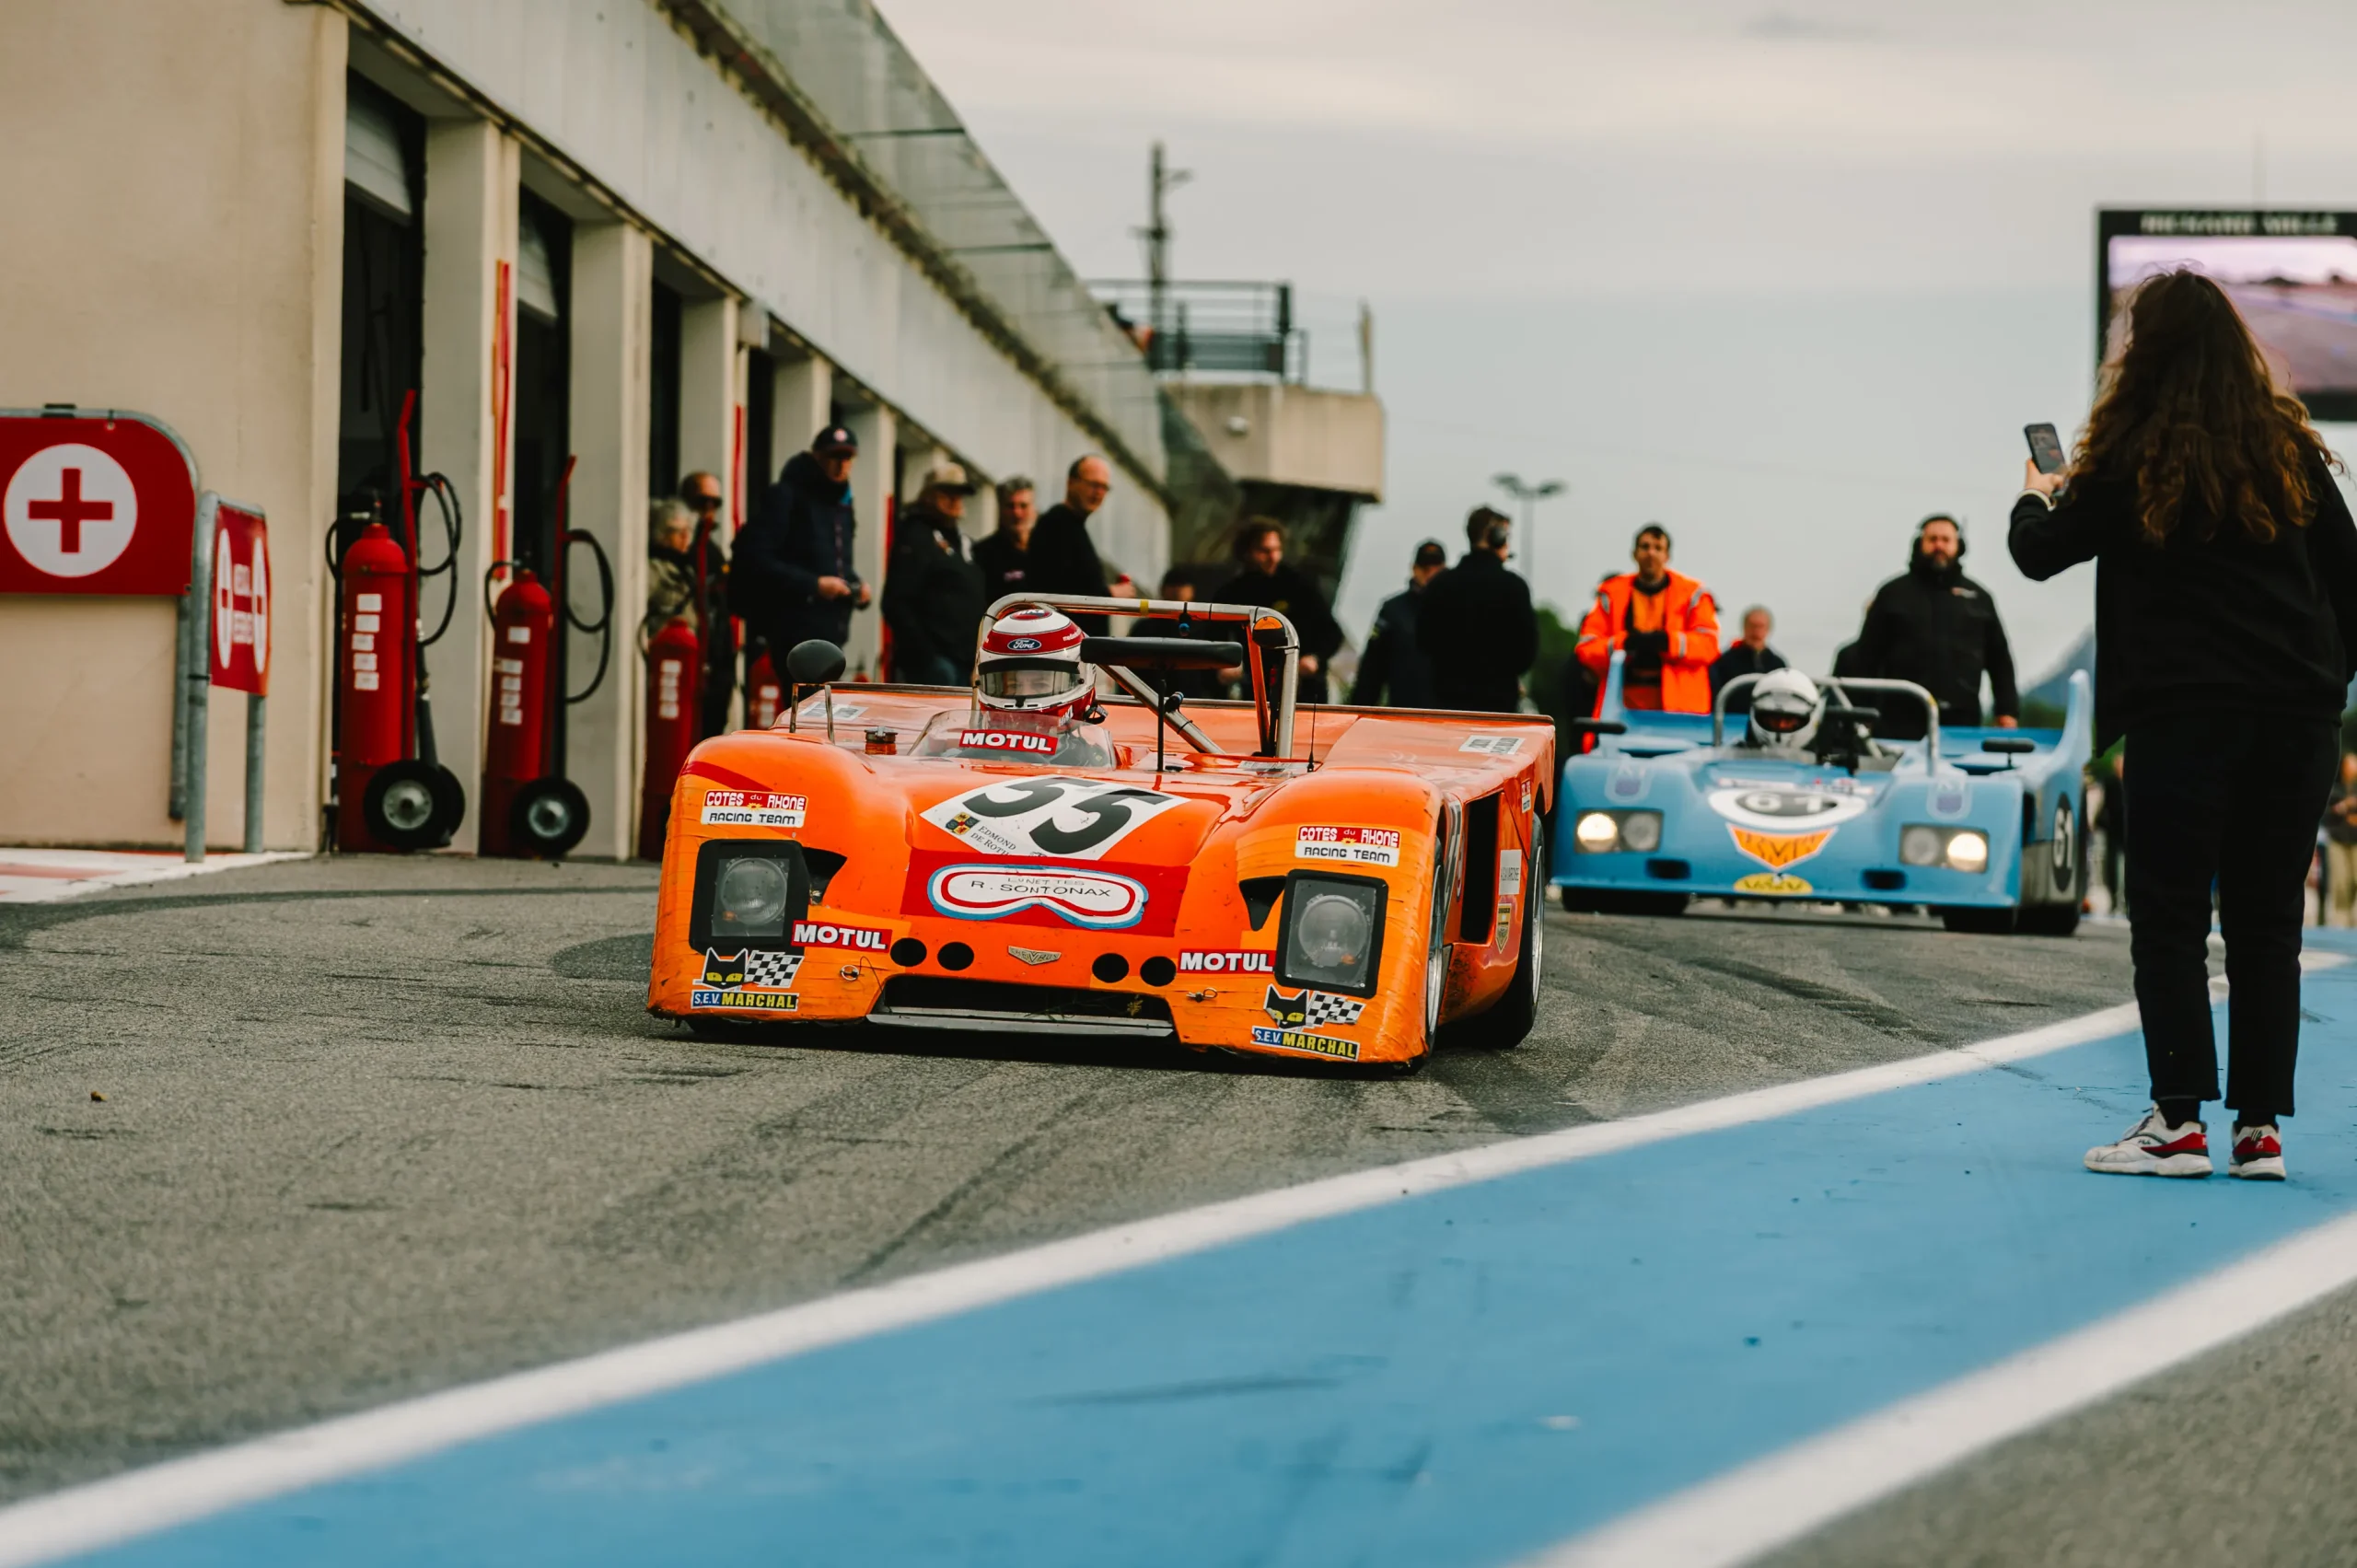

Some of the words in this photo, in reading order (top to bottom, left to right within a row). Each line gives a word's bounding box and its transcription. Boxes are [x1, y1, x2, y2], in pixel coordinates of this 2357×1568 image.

[1013, 639, 1035, 650] Ford
[962, 732, 1052, 752] MOTUL
[706, 792, 745, 807] COTES
[767, 795, 806, 810] RHONE
[709, 812, 752, 822] RACING
[759, 814, 795, 825] TEAM
[962, 776, 1173, 854] 55
[970, 832, 985, 842] DE
[978, 826, 1016, 851] EDMOND
[1299, 828, 1338, 842] COTES
[1361, 829, 1399, 847] RHONE
[2053, 807, 2073, 868] 61
[1304, 847, 1348, 858] RACING
[1353, 849, 1390, 864] TEAM
[1000, 883, 1111, 898] SONTONAX
[793, 923, 888, 950] MOTUL
[1179, 952, 1273, 972] MOTUL
[693, 993, 720, 1005] S.E.V.
[721, 993, 795, 1009] MARCHAL
[1254, 1029, 1281, 1044] S.E.V.
[1282, 1032, 1356, 1059] MARCHAL
